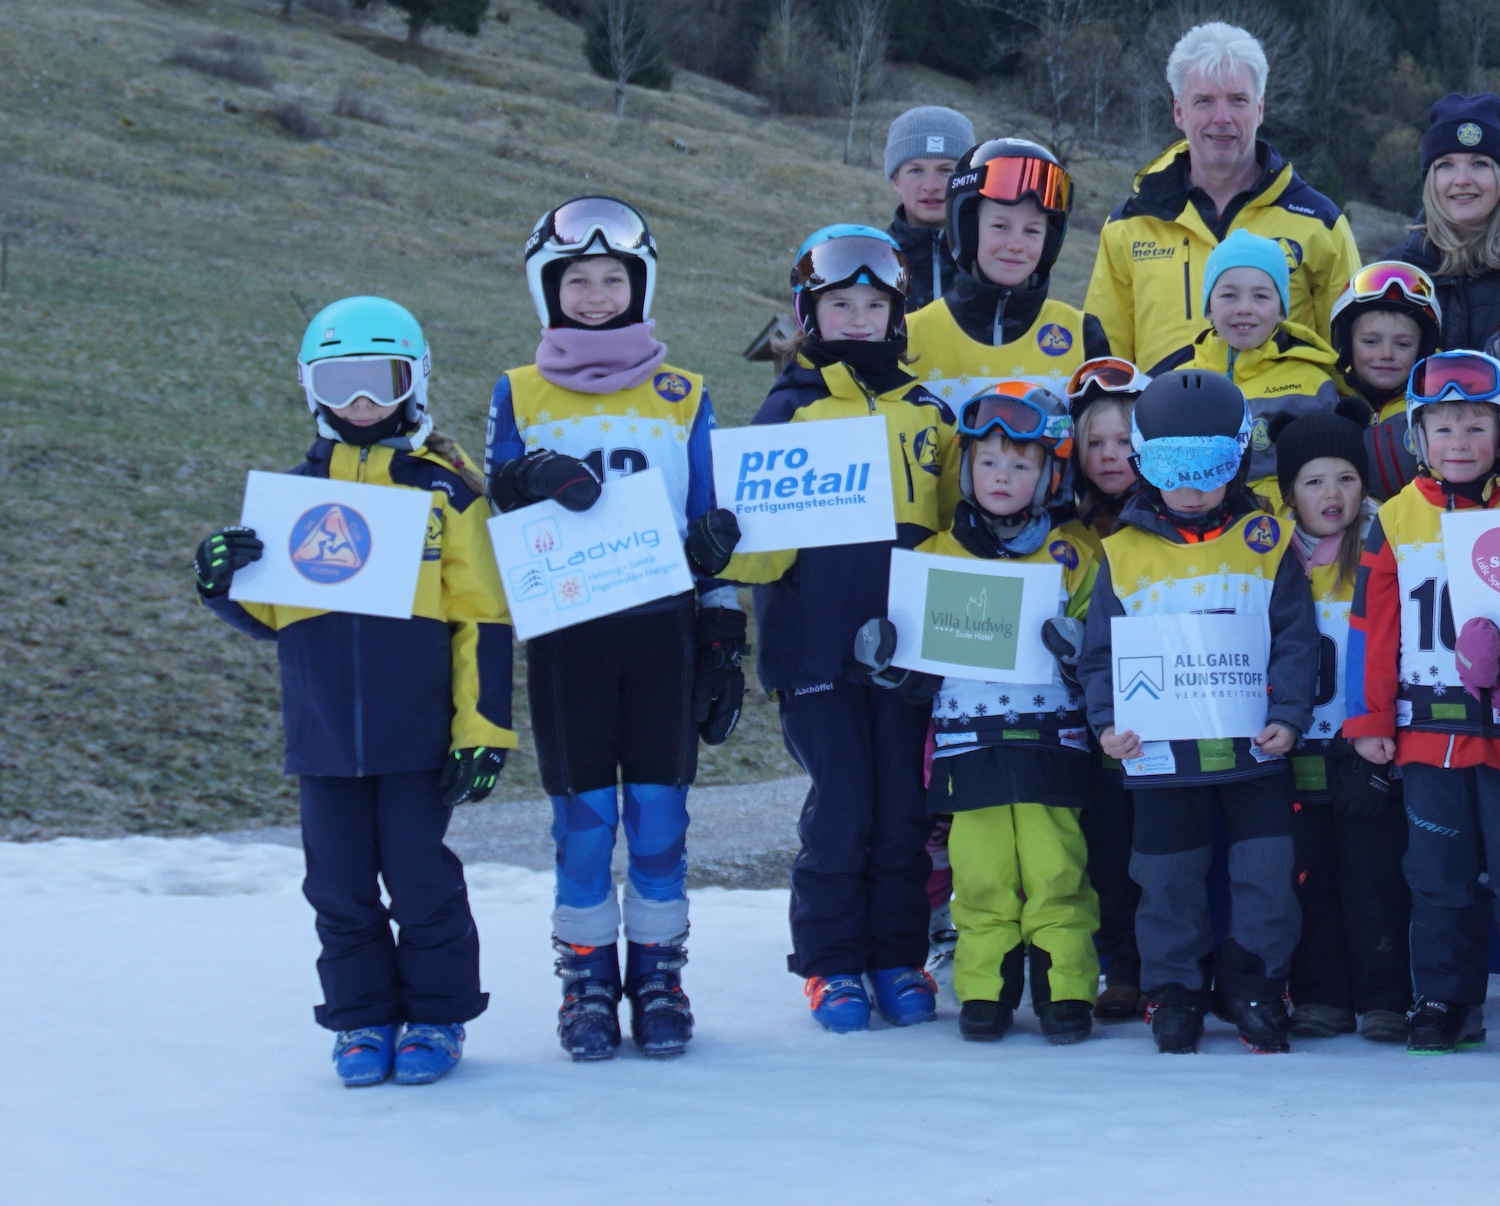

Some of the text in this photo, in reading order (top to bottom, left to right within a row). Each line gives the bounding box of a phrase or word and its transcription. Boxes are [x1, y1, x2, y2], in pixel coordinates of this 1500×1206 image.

[951, 172, 978, 189] SMITH
[739, 447, 809, 481] pro
[735, 463, 870, 502] metall
[736, 494, 867, 514] Fertigungstechnik
[545, 529, 661, 573] Ladwig
[588, 566, 622, 581] Heizung
[591, 562, 681, 593] Regenerative Energien
[931, 611, 1013, 639] Villa Ludwig
[955, 630, 994, 642] Suite Hotel
[1174, 653, 1250, 668] ALLGAIER
[1174, 672, 1262, 687] KUNSTSTOFF
[1175, 691, 1262, 699] VERARBEITUNG
